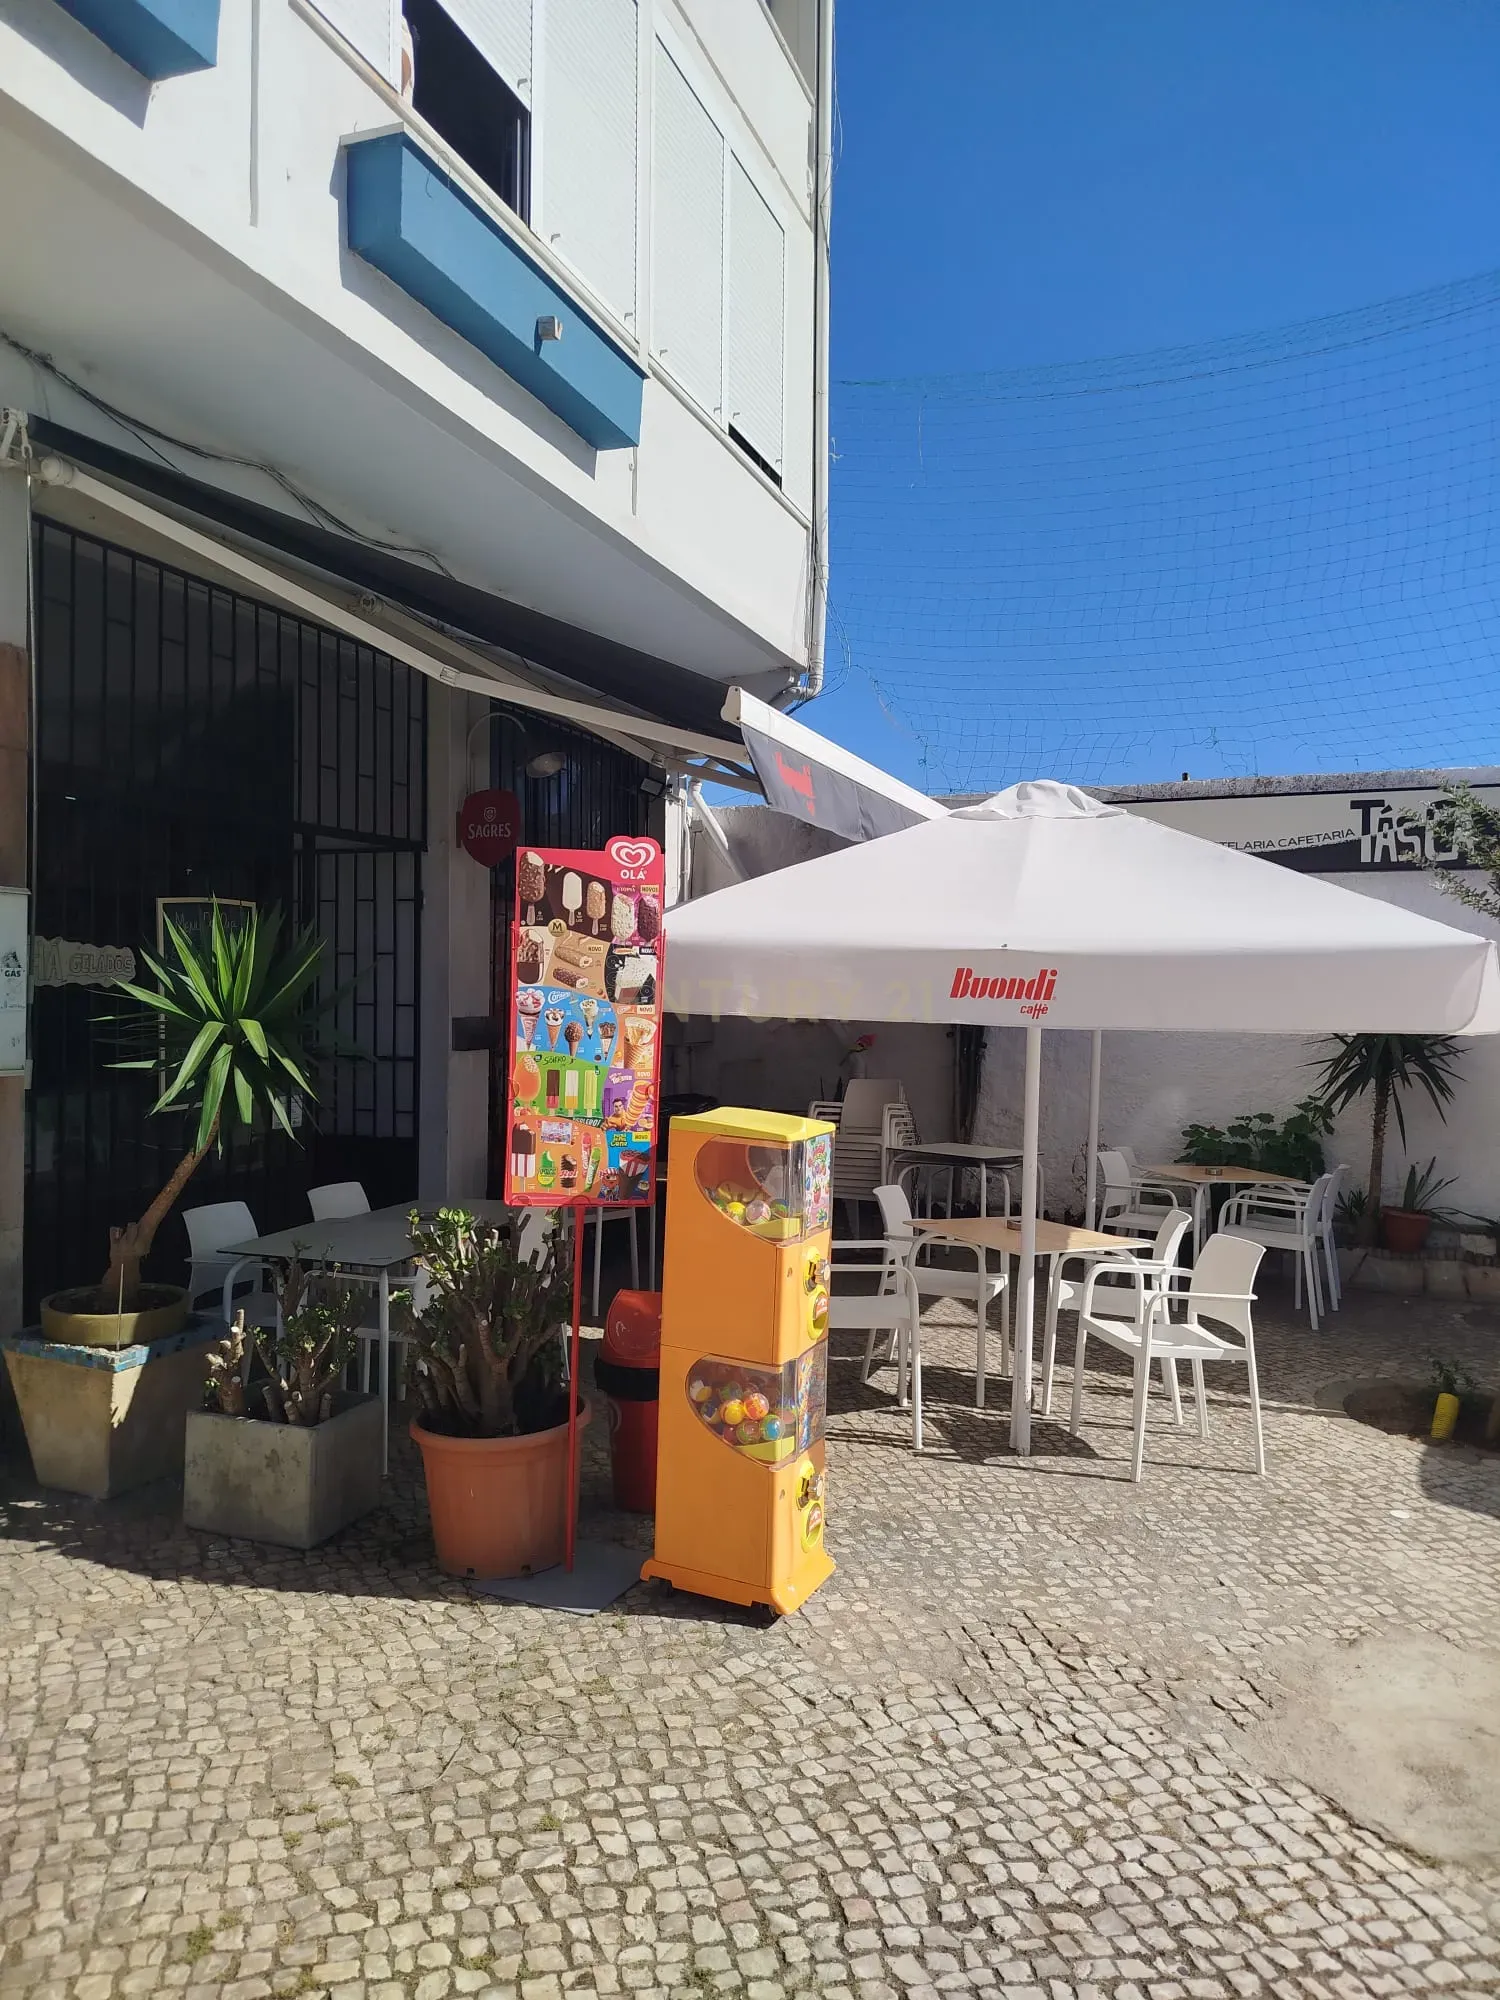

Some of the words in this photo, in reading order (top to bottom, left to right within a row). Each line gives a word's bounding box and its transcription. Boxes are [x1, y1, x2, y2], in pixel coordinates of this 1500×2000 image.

[467, 822, 512, 840] SAGRES
[1277, 828, 1356, 848] CAFETARIA
[619, 866, 646, 880] OLÁ
[587, 945, 602, 953] NOVO
[949, 967, 1058, 1001] Buondi
[638, 1006, 653, 1014] NOVO
[1019, 1002, 1049, 1020] caffè
[636, 1070, 651, 1078] NOVO
